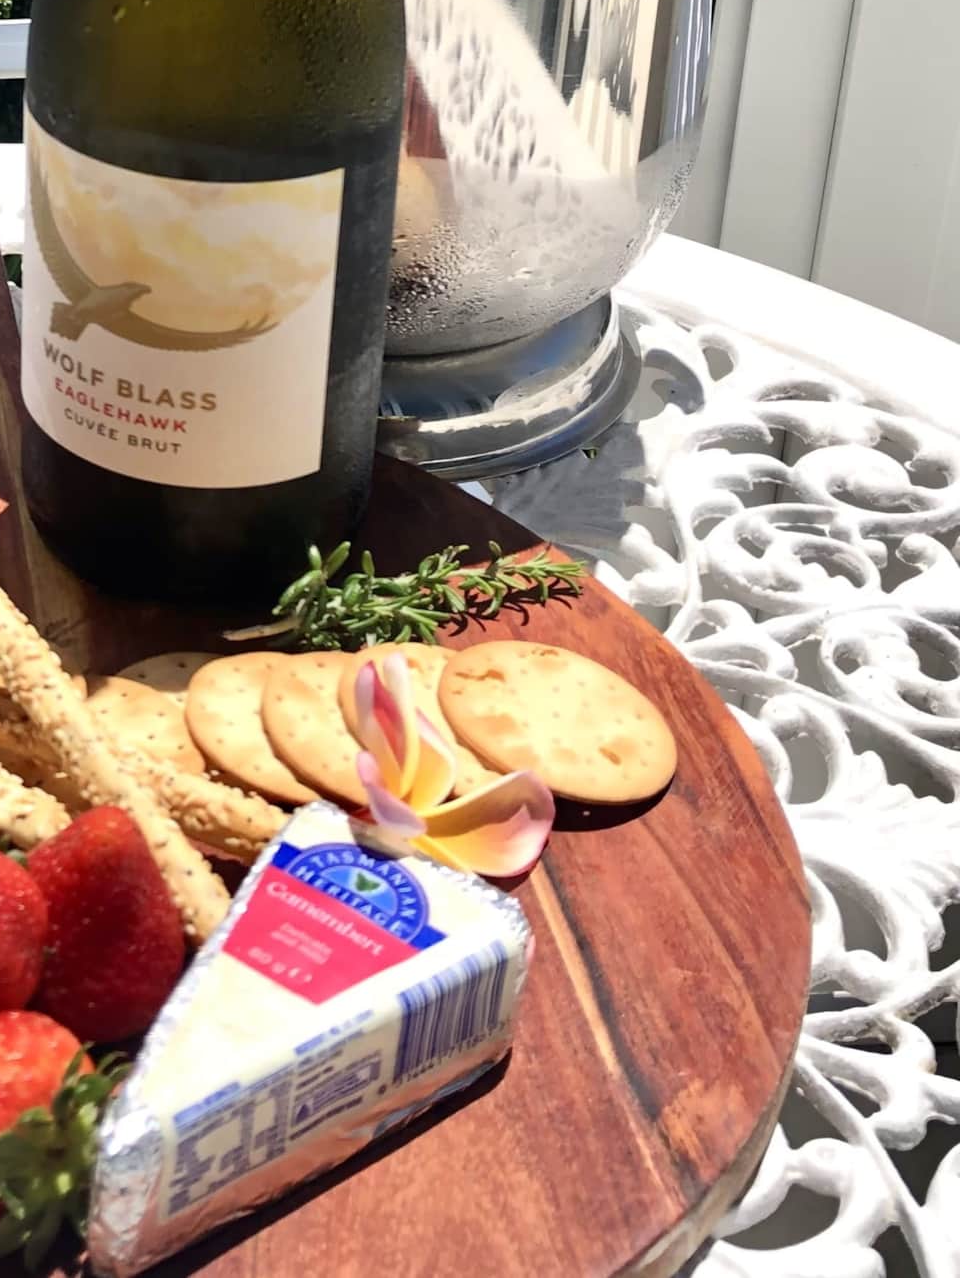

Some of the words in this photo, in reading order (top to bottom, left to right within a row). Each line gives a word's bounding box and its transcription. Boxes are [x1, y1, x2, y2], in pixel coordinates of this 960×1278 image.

[43, 338, 105, 387] WOLF
[116, 378, 218, 412] BLASS
[54, 377, 188, 434] EAGLEHAWK
[127, 433, 182, 455] BRUT
[266, 881, 385, 956] Camembert
[295, 865, 408, 937] HERITAGE
[310, 851, 417, 920] TASMANIAN
